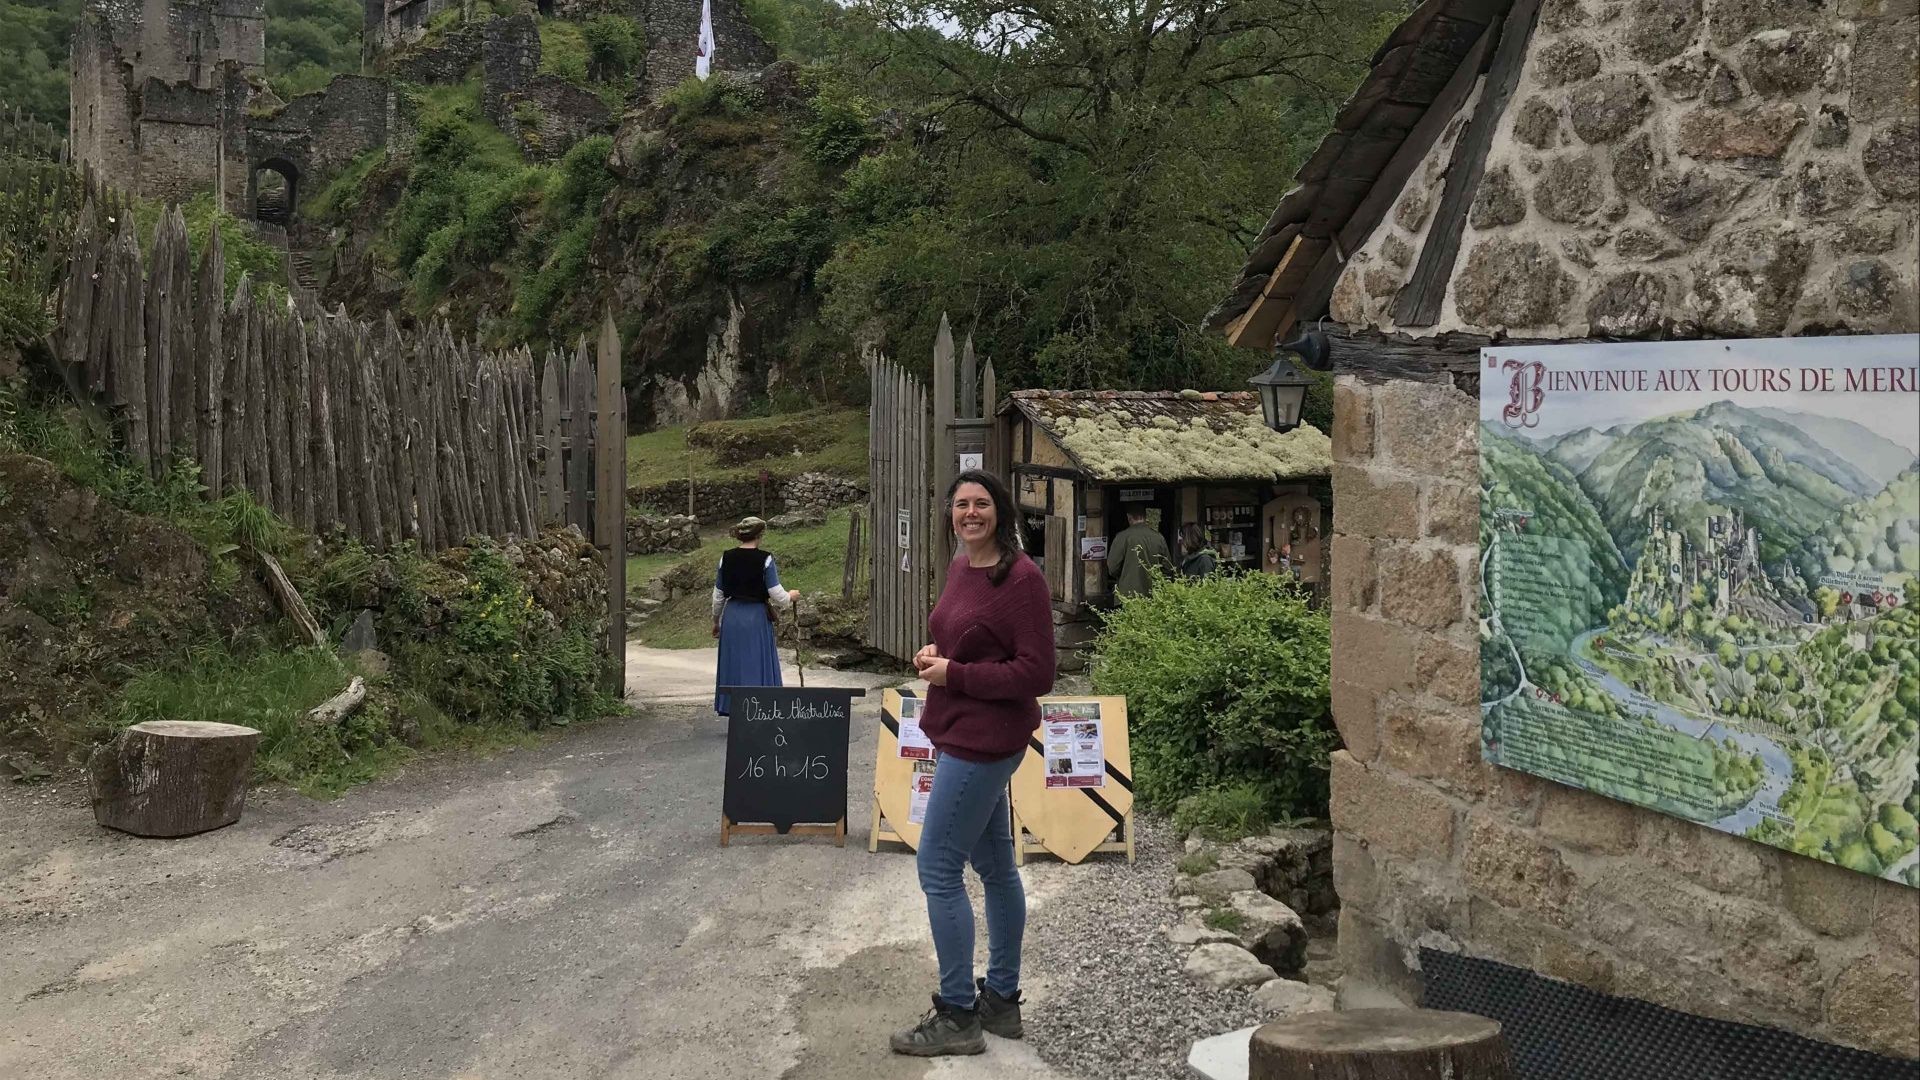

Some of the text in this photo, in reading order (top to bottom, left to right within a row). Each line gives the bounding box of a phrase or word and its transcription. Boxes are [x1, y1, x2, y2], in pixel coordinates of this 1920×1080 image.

[1502, 359, 1648, 427] BIENVENUE
[1655, 369, 1702, 391] AUX
[1708, 367, 1792, 392] TOURS
[1800, 367, 1835, 392] DE
[743, 697, 785, 721] Visite
[774, 726, 788, 747] à
[737, 754, 829, 780] 16 h 15
